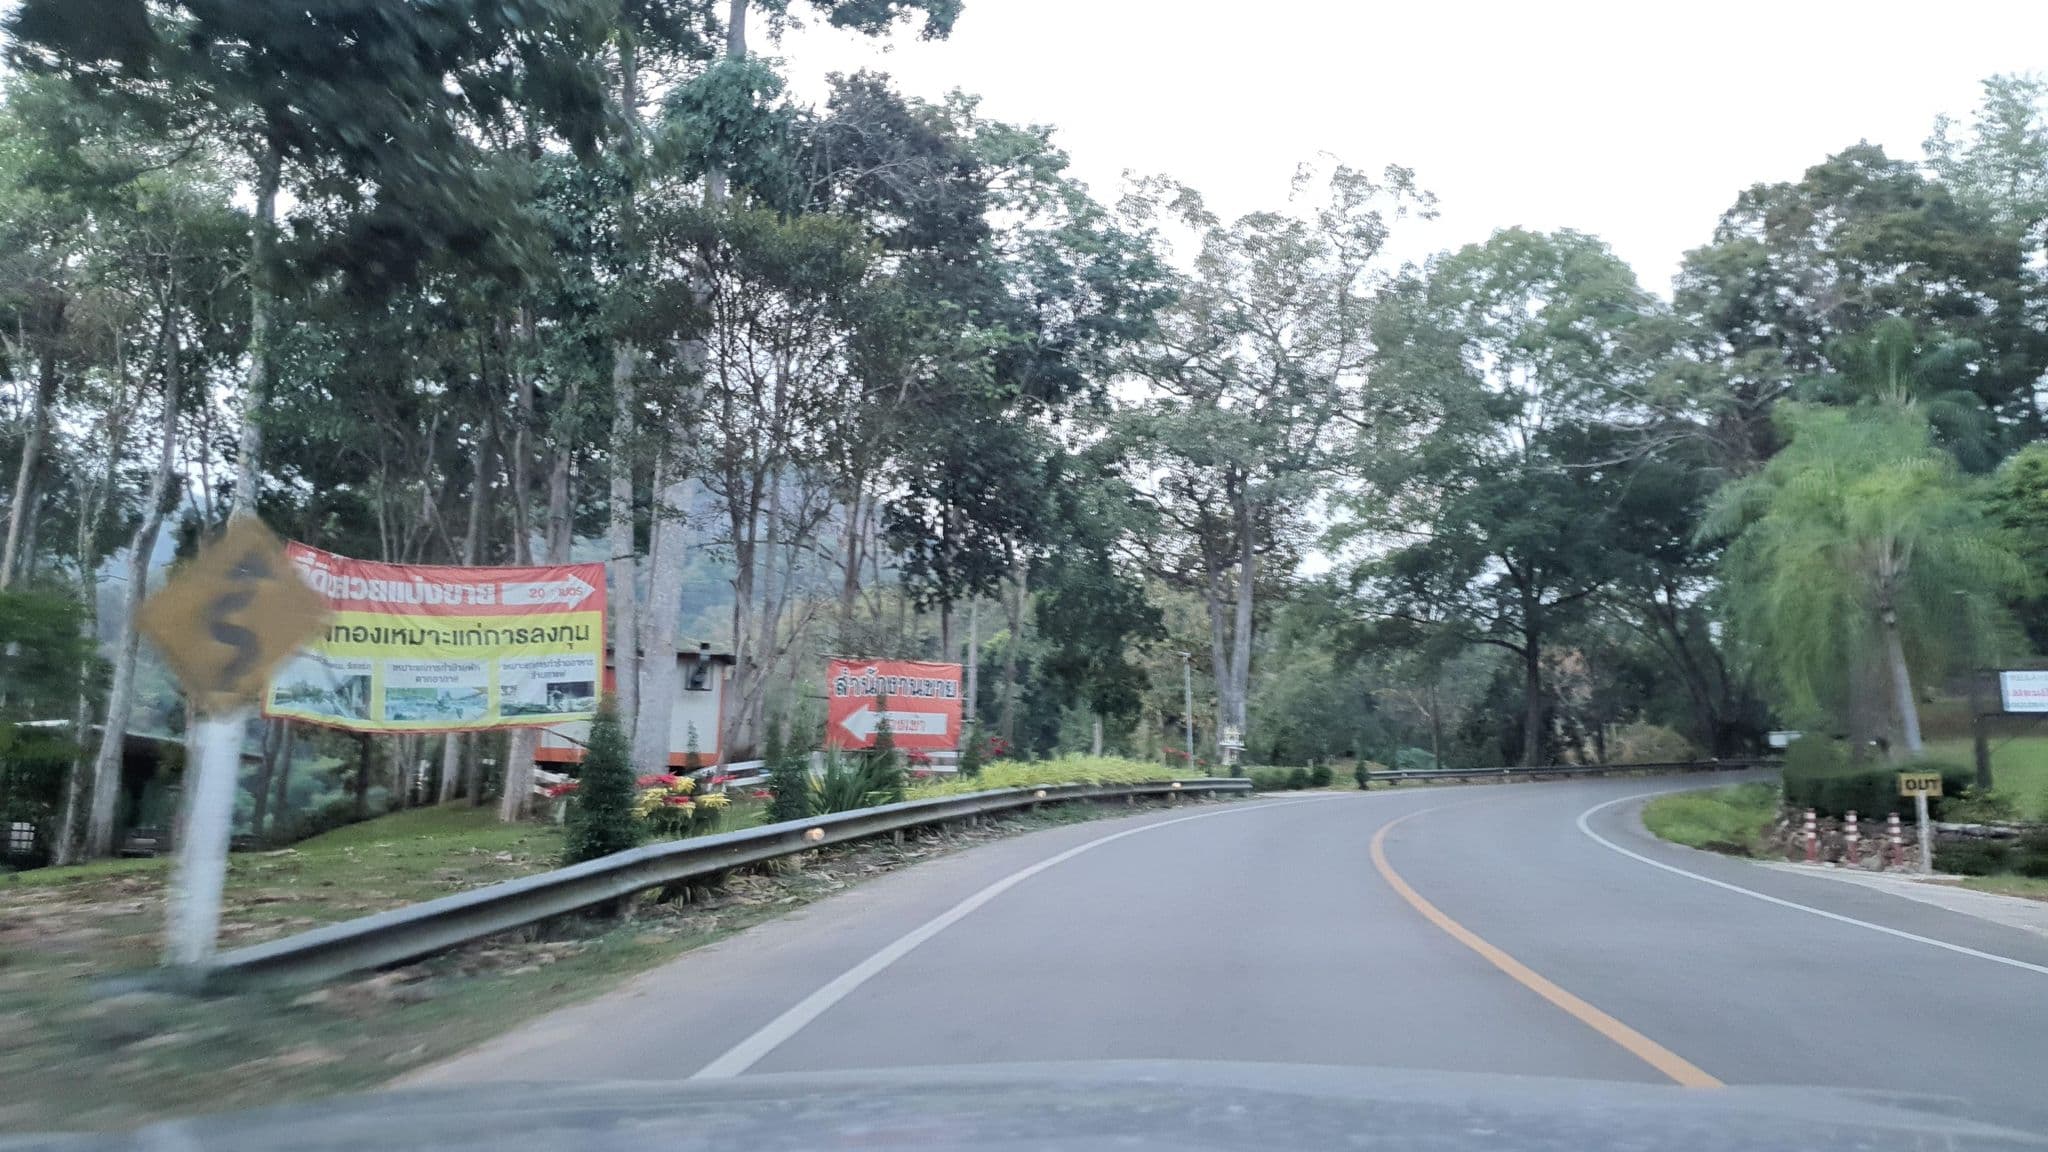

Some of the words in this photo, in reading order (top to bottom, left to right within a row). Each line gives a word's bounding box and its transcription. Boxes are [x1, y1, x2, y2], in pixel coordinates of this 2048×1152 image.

[324, 622, 590, 649] ทองเหมาะแก่การลงทุน
[834, 667, 958, 699] สำนักงานขาย
[1905, 779, 1938, 790] OUT
